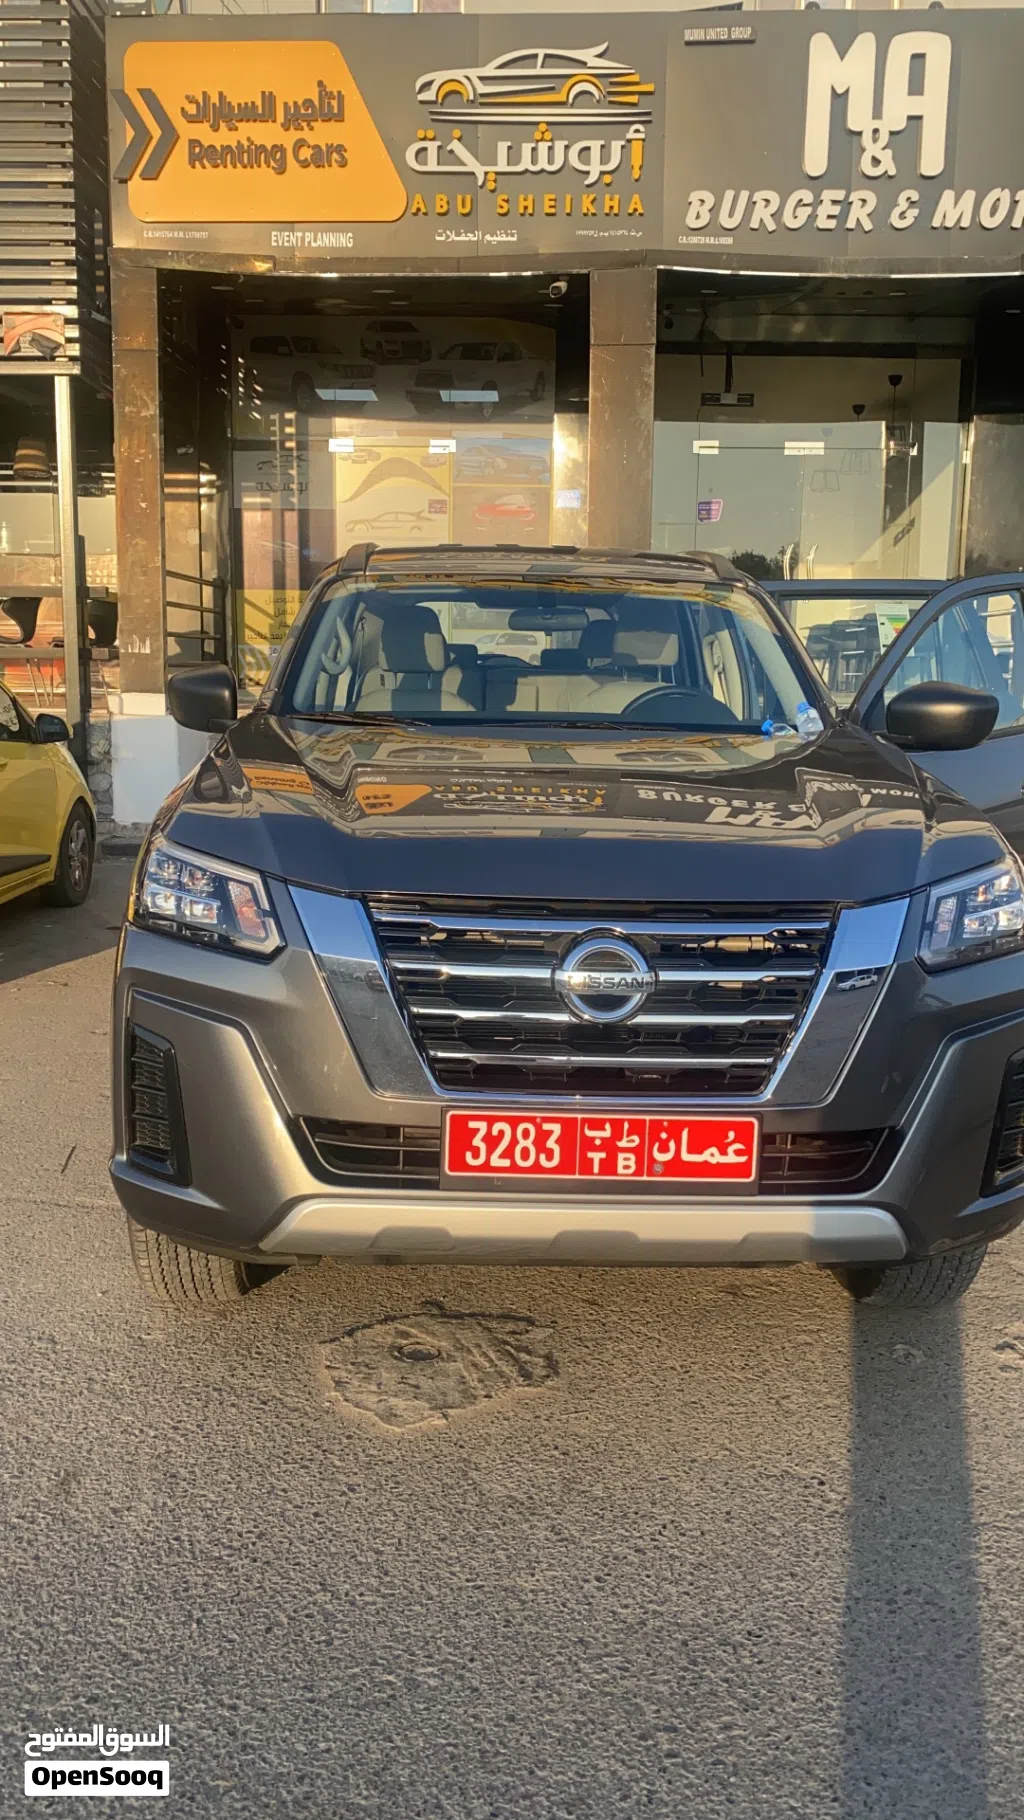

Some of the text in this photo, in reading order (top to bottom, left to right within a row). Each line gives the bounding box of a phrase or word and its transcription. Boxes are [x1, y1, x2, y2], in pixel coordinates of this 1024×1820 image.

[706, 27, 728, 40] UNITED
[731, 26, 752, 39] GROUP
[180, 80, 344, 132] لتأجير السيارات
[187, 137, 347, 174] Renting Cars
[411, 193, 645, 216] ABU SHEIKHA
[684, 189, 878, 233] BURGER
[889, 189, 919, 230] &
[271, 231, 353, 248] EVENT PLANNING
[435, 229, 517, 244] تنظيم الحفلات
[566, 974, 646, 991] NISSAN
[465, 1121, 562, 1168] 3283
